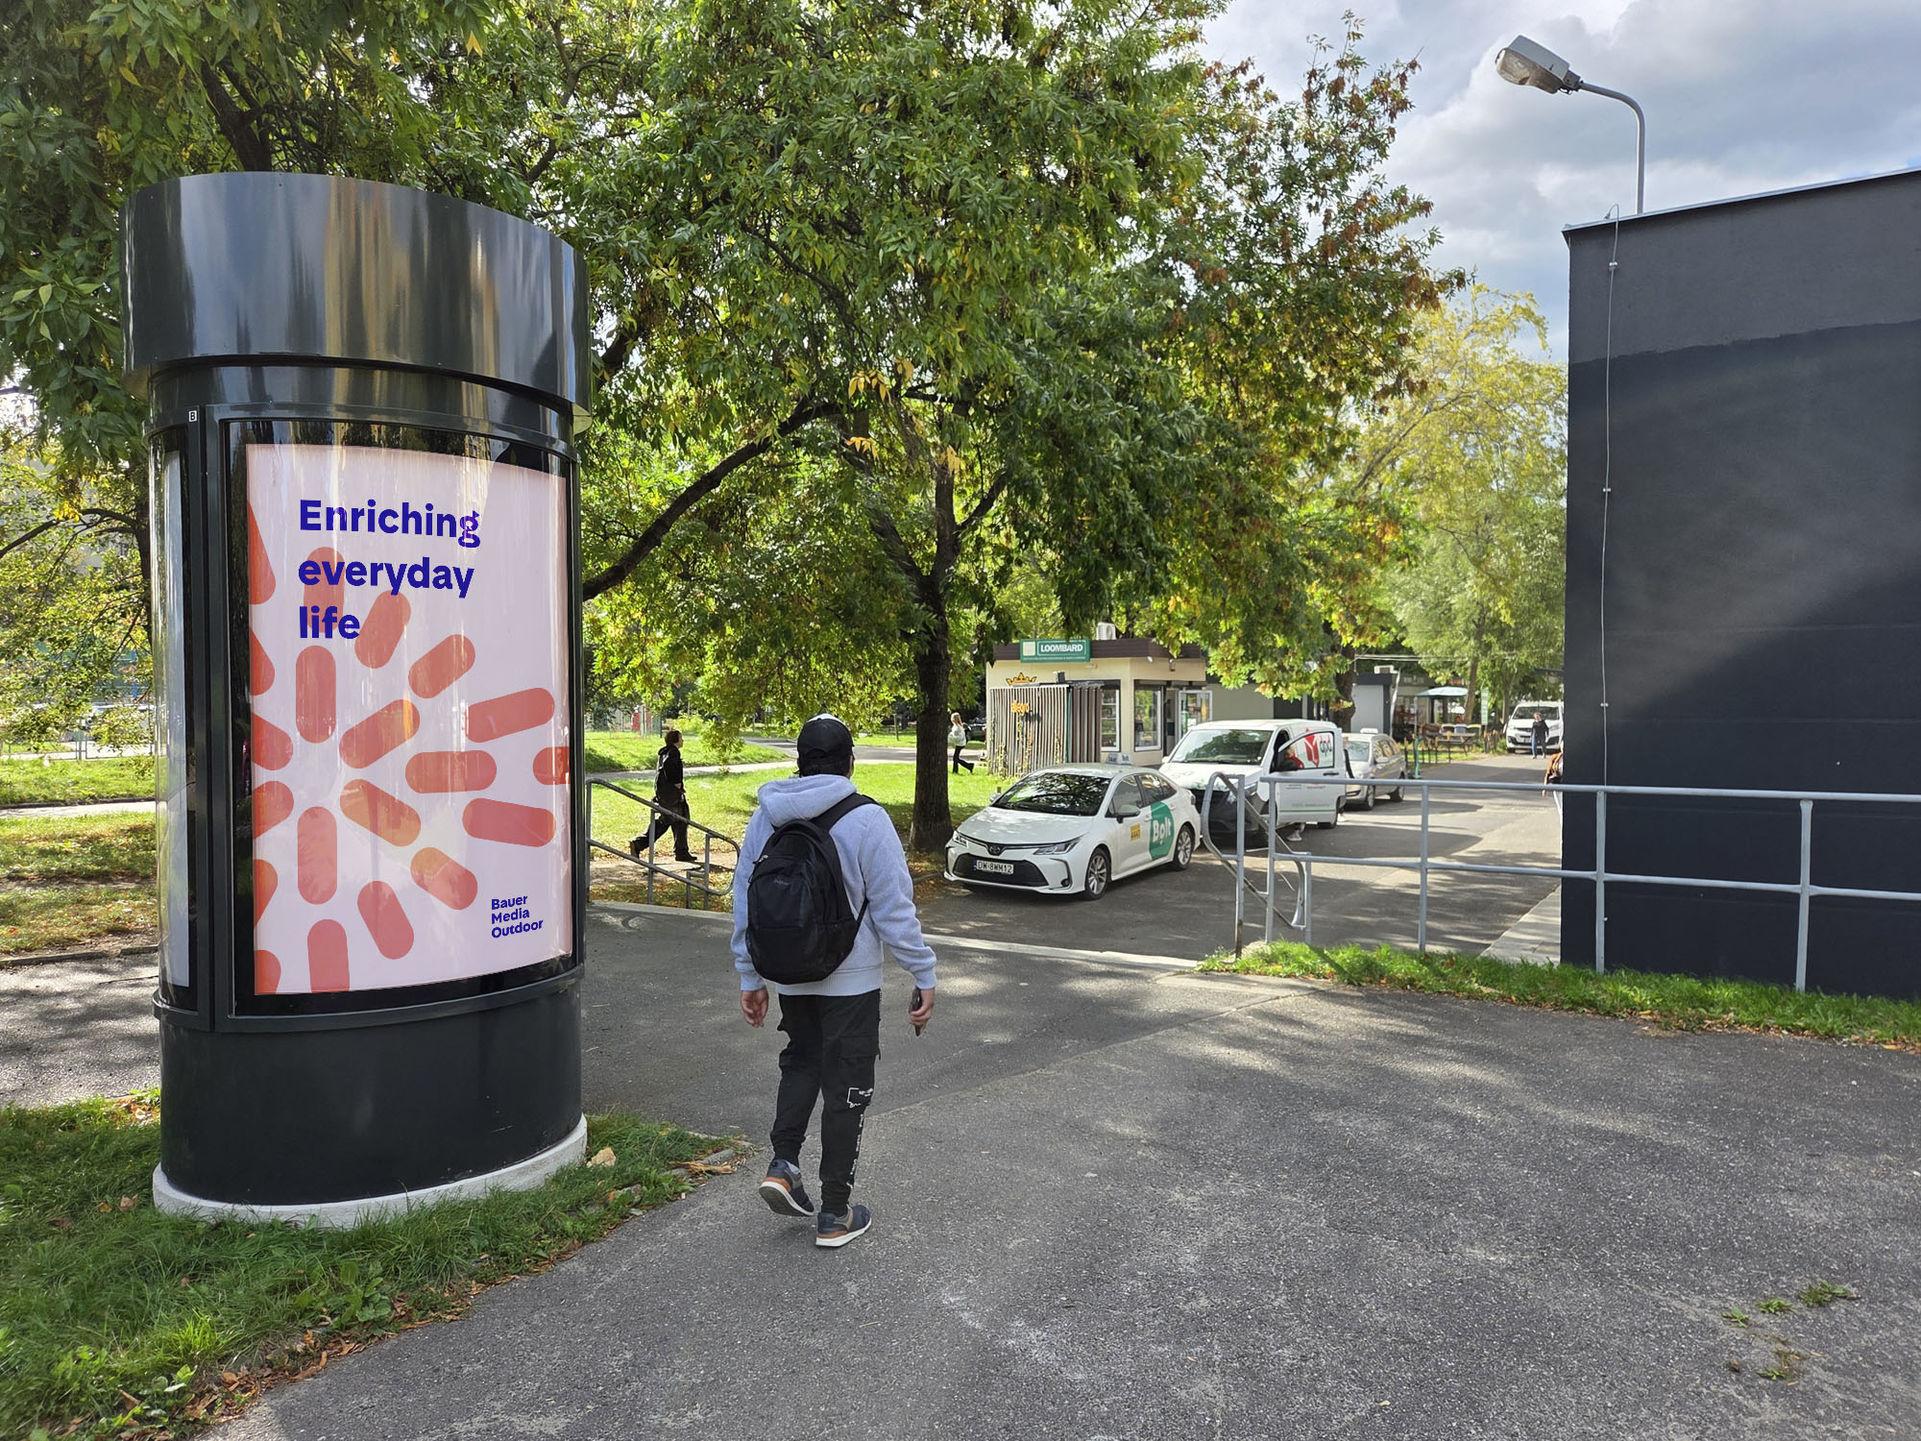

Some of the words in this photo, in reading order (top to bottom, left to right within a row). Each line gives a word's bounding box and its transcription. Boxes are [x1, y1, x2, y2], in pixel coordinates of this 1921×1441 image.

[299, 498, 481, 549] Enriching
[298, 556, 475, 599] everyday
[299, 605, 361, 640] life
[1040, 644, 1084, 653] LOOMBARD
[1320, 734, 1333, 757] dpd
[1152, 816, 1172, 845] Bolt
[491, 895, 528, 911] Bauer
[491, 907, 531, 925] Media
[491, 919, 544, 939] Outdoor
